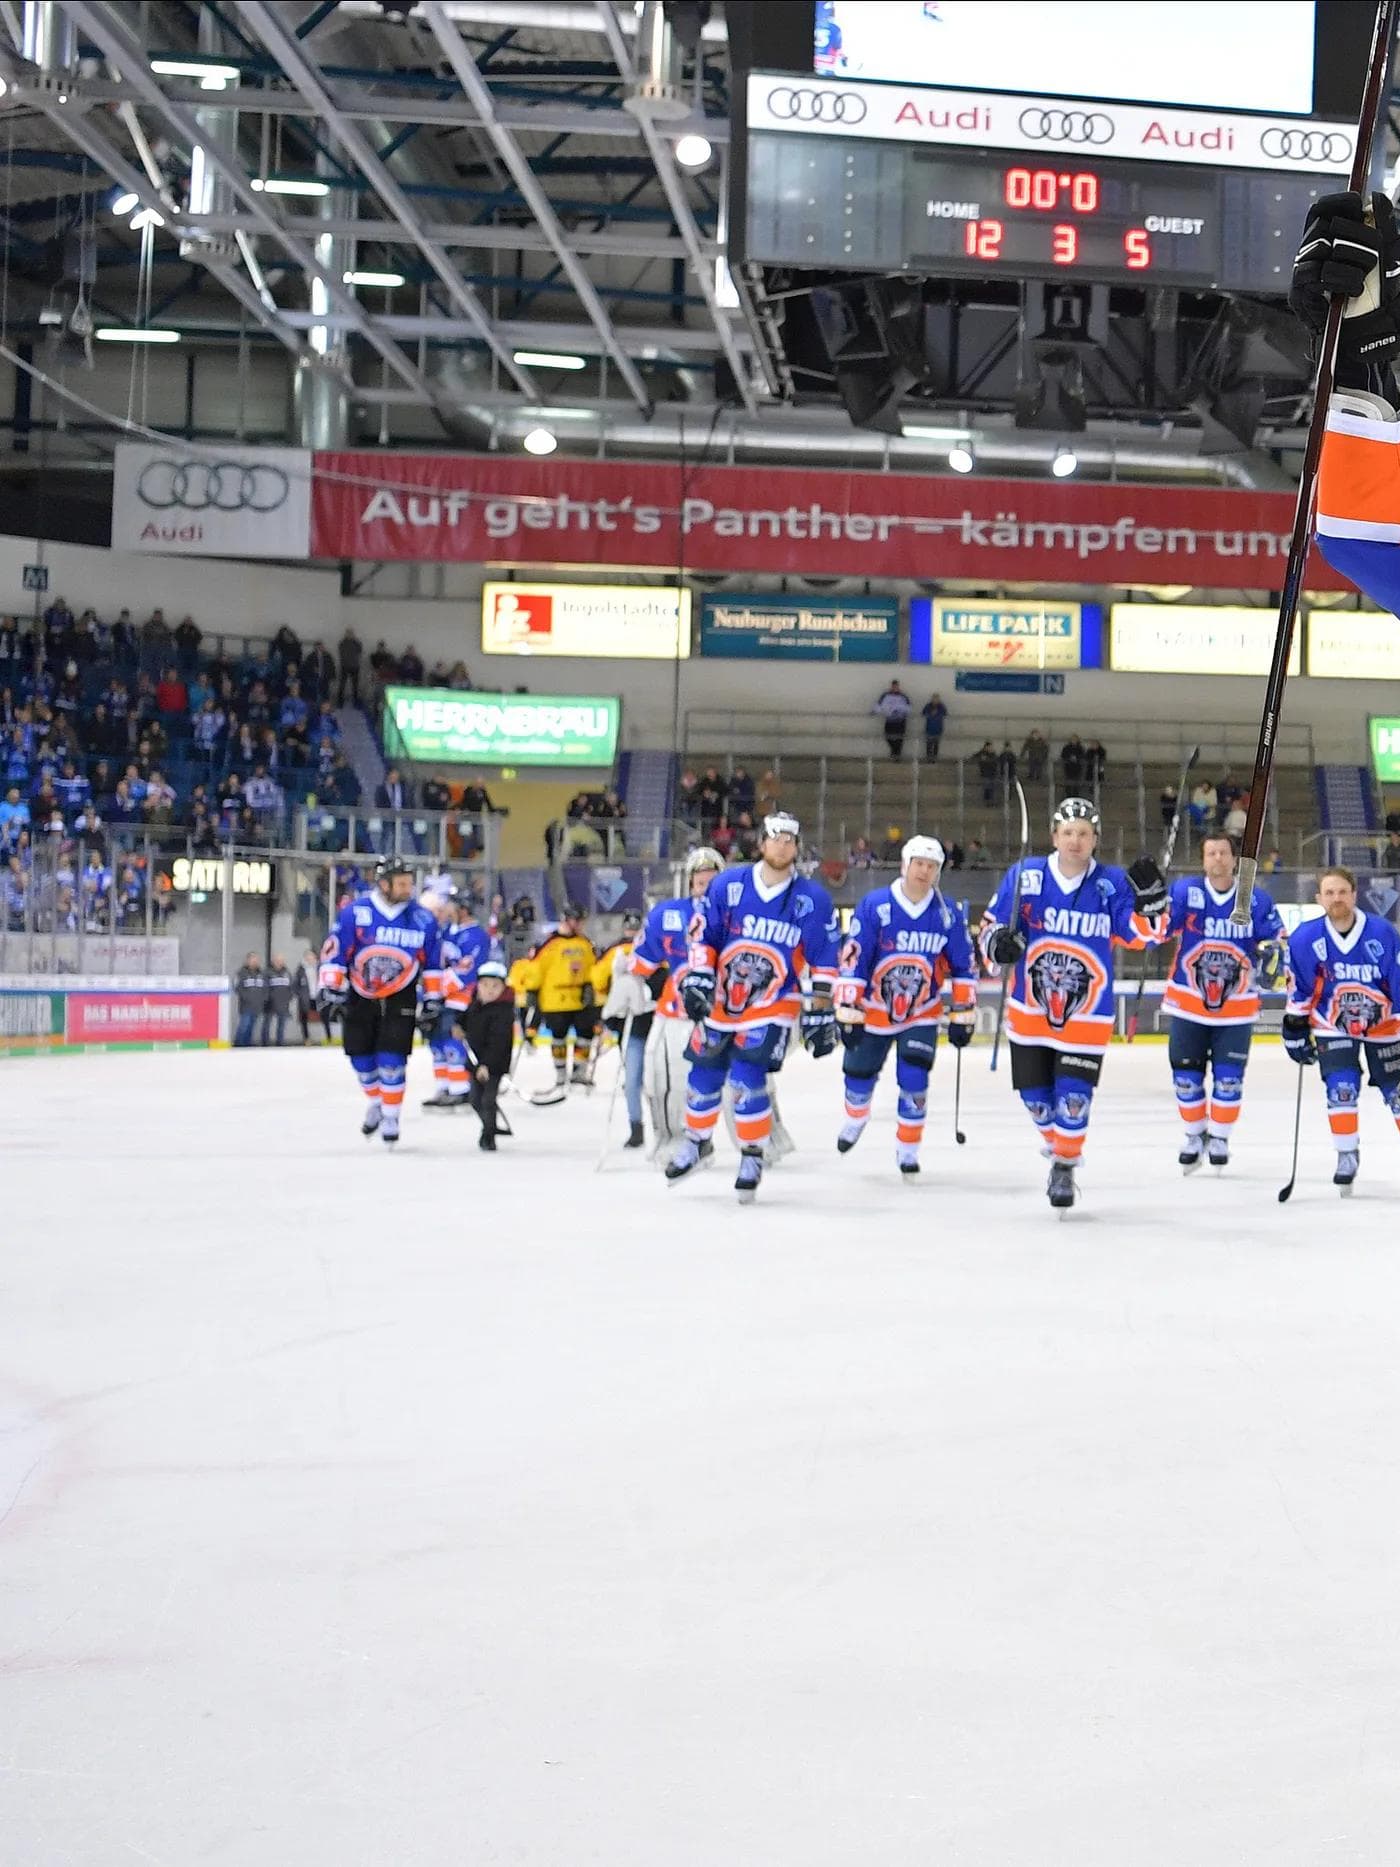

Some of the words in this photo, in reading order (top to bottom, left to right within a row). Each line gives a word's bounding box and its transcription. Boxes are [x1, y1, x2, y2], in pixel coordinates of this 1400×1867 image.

[895, 101, 992, 132] Audi
[1141, 122, 1235, 152] Audi
[927, 200, 980, 220] HOME
[1144, 215, 1204, 236] GUEST
[965, 219, 1002, 260] 12
[1053, 225, 1077, 263] 3
[1125, 229, 1150, 268] 5
[140, 522, 204, 542] Audi
[361, 490, 469, 527] Auf
[681, 499, 899, 543] Panther
[960, 511, 1198, 559] kämpfen
[714, 607, 798, 633] Neuburger
[800, 611, 889, 633] Rundschau
[948, 613, 994, 632] LIFE
[1000, 614, 1065, 634] PARK
[1045, 675, 1063, 693] N
[111, 1004, 193, 1023] HANDWERK
